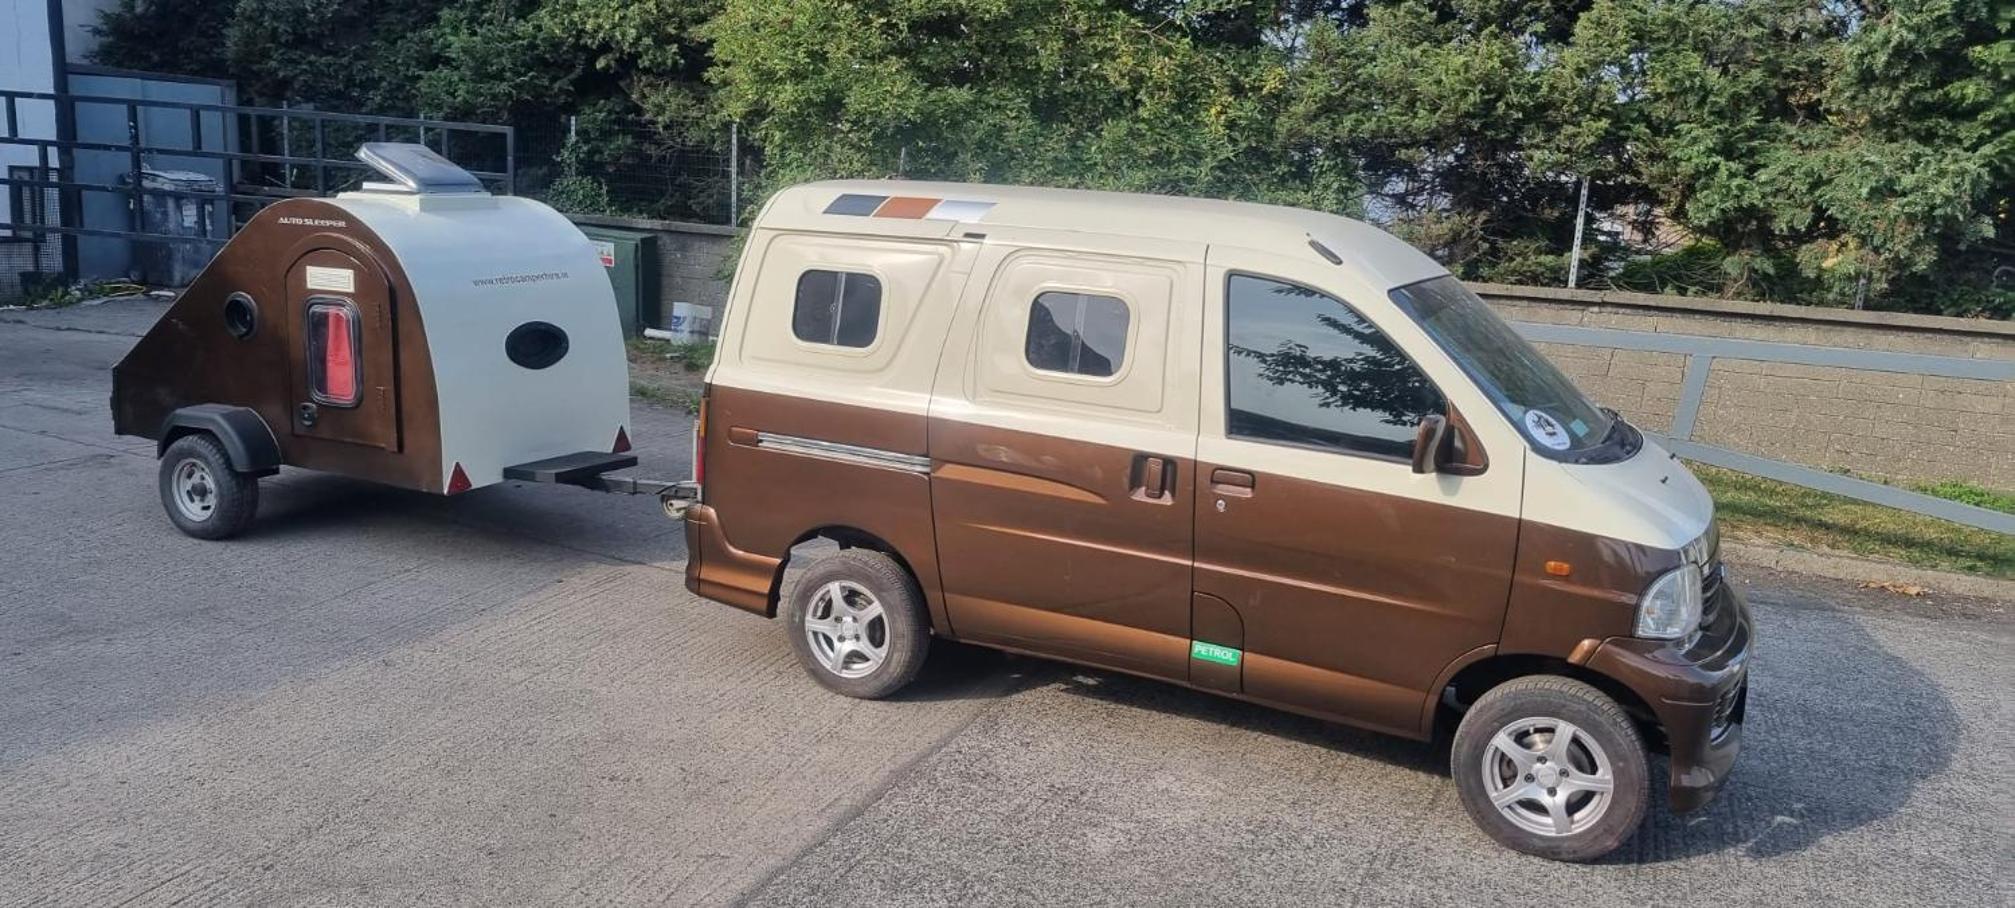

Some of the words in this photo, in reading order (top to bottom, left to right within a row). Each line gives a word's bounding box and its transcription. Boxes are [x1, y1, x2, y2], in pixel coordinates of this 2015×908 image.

[278, 216, 302, 225] AUTO
[303, 218, 347, 228] SLEEPER
[1194, 644, 1236, 661] PETROL
